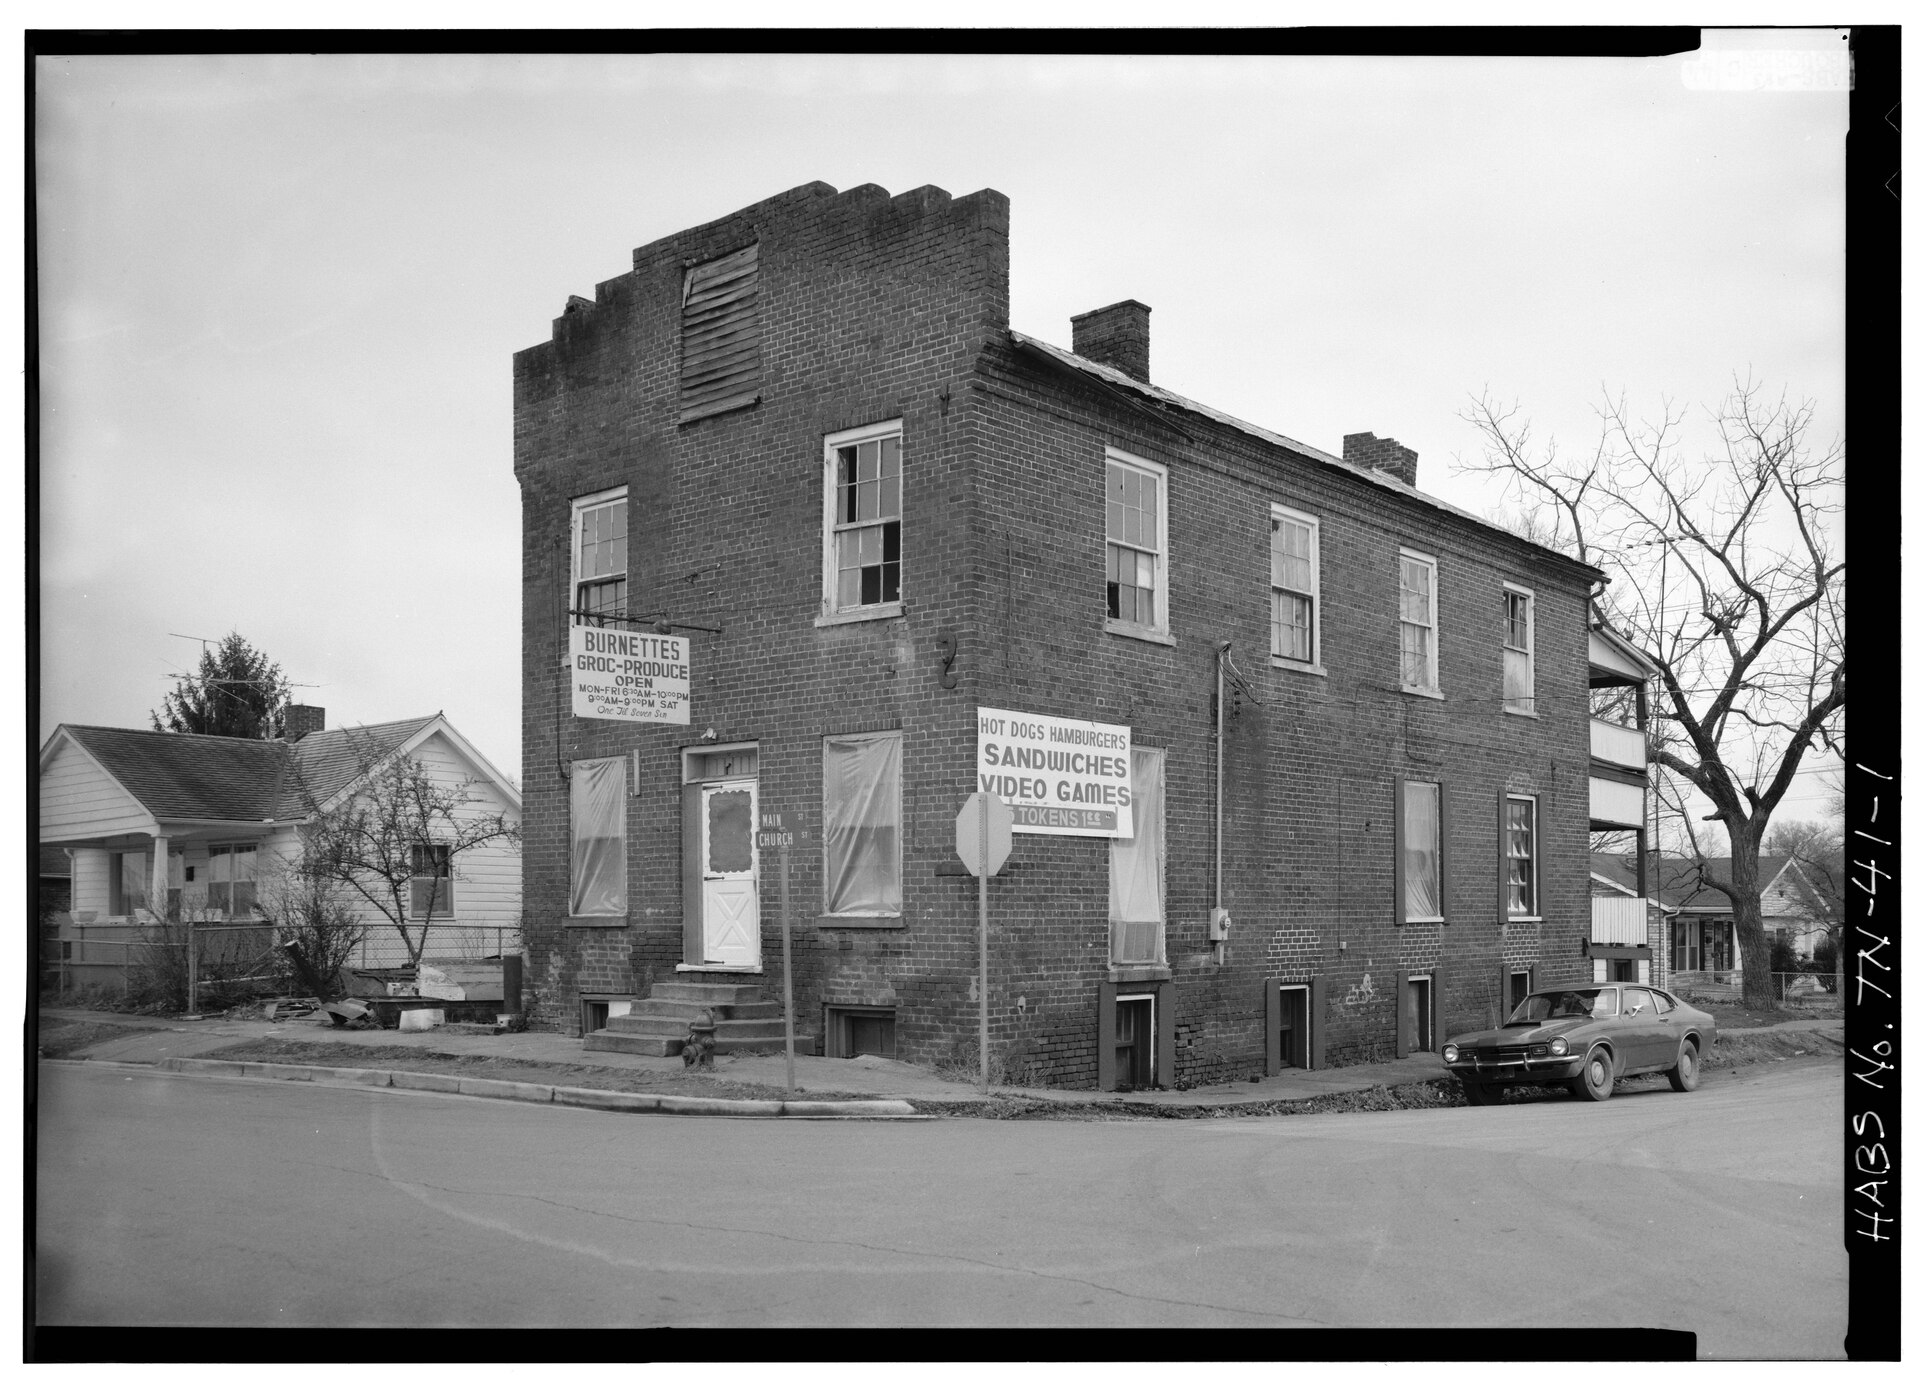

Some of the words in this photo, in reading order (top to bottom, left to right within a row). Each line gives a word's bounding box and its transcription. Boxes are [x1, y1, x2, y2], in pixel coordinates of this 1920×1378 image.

[585, 631, 680, 661] BURNETTES
[577, 654, 688, 680] GROC-PRODUCE
[579, 683, 620, 696] MON-FRI
[615, 675, 653, 688] OPEN
[597, 705, 614, 715] One
[630, 708, 652, 718] Seven
[660, 700, 678, 709] SAT
[980, 717, 1005, 736] HOT
[1010, 721, 1045, 741] DOGS
[1050, 726, 1126, 750] HAMBURGERS
[984, 743, 1127, 778] SANDWICHES
[980, 773, 1047, 800] VIDEO
[1056, 780, 1131, 807] GAMES
[762, 813, 782, 827] MAIN
[797, 813, 804, 821] ST
[1019, 807, 1079, 827] TOKENS
[759, 832, 793, 847] CHURCH
[801, 831, 808, 839] ST
